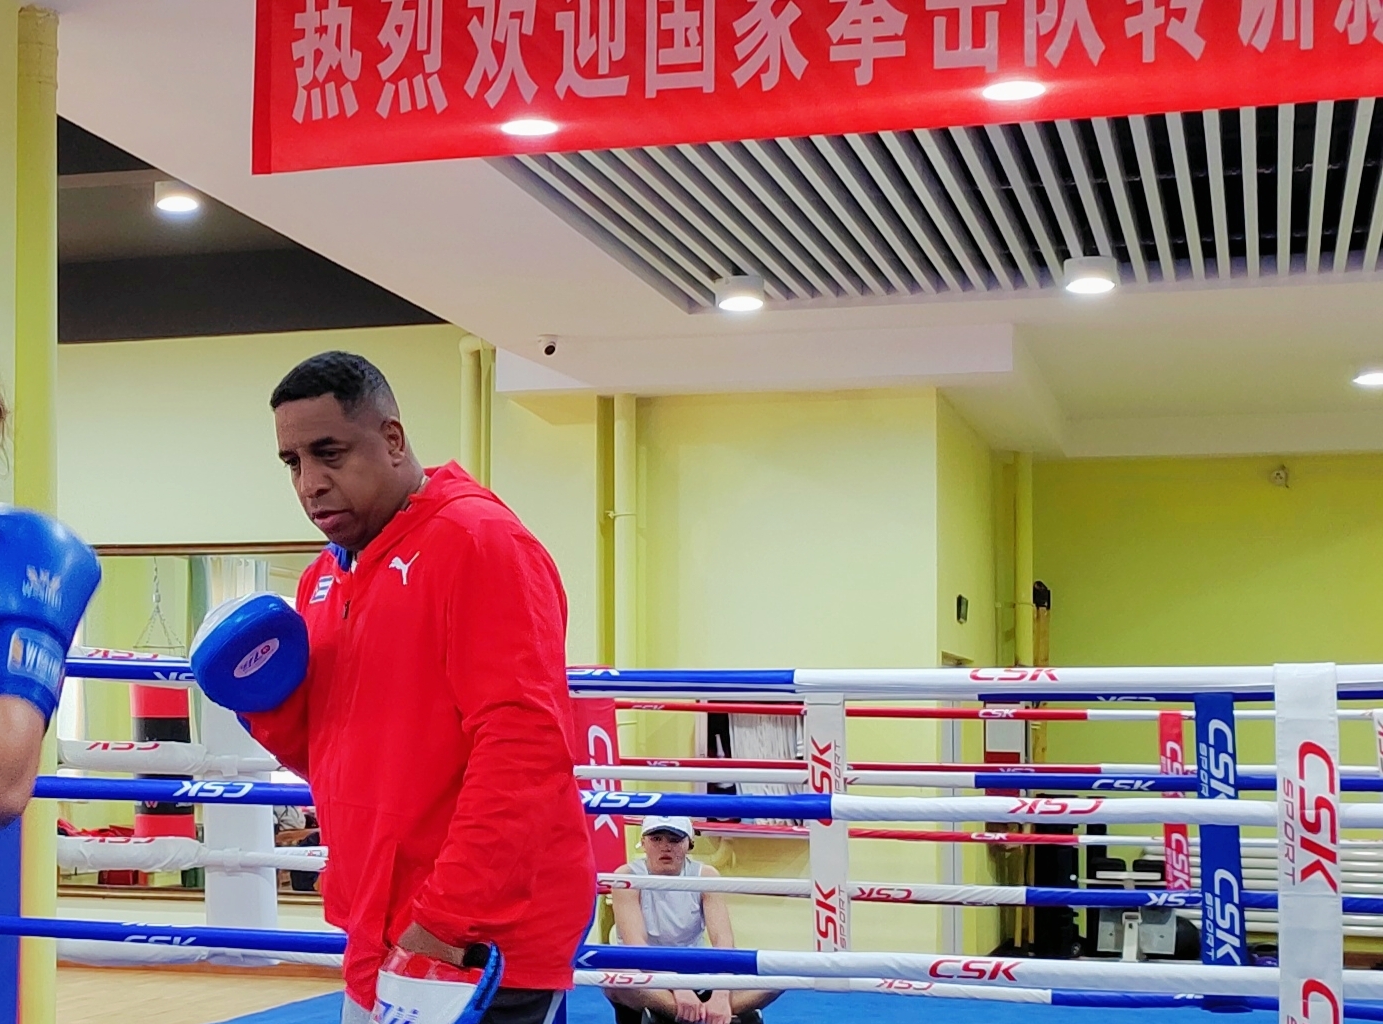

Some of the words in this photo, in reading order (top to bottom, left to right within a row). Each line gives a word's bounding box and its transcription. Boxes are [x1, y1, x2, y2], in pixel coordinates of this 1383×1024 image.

[290, 0, 1383, 124] 热烈欢迎国家拳击队转
[969, 668, 1059, 682] CSK
[978, 709, 1017, 719] CSK
[1199, 742, 1209, 798] SPOR
[173, 781, 254, 798] CSK
[1092, 779, 1156, 791] CSK
[580, 790, 663, 808] CSK
[1007, 799, 1104, 815] CSK
[1298, 741, 1338, 894] CSK
[970, 832, 1009, 841] CSK
[1283, 777, 1296, 885] SPORT
[1171, 833, 1190, 890] CSK
[857, 886, 912, 900] CSK
[1214, 868, 1242, 965] CSK
[1205, 892, 1216, 961] SPORT
[599, 972, 654, 985] CSK
[929, 959, 1021, 982] CSK
[876, 977, 934, 991] CSK
